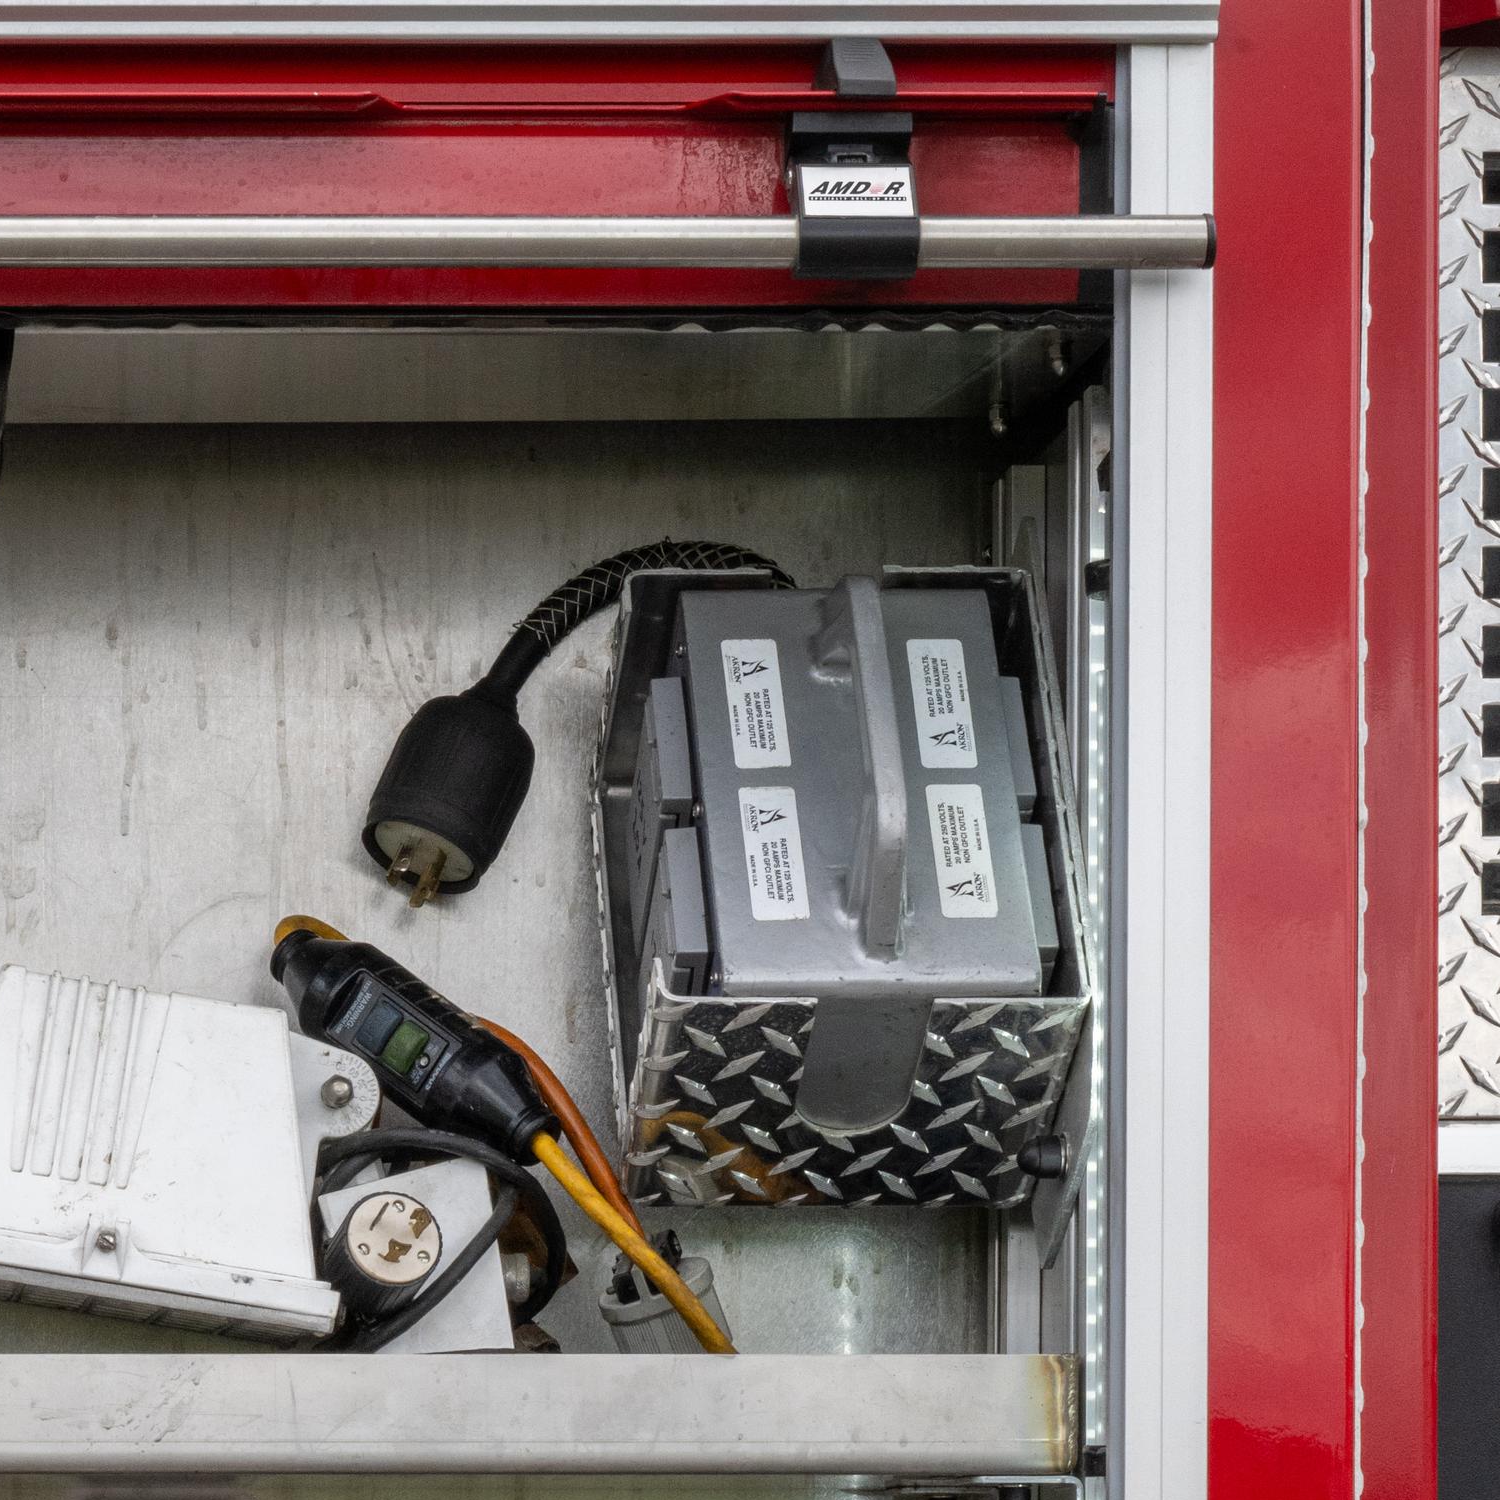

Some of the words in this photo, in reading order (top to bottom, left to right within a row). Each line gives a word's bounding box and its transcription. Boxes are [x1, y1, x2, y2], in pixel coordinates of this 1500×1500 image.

[732, 656, 741, 683] AKRON
[931, 658, 941, 687] MAXIMUM
[941, 659, 949, 682] OUTLET
[746, 708, 754, 722] GFCI
[754, 700, 763, 718] AMPS
[928, 697, 936, 717] RATED
[938, 707, 944, 715] 20
[748, 724, 757, 748] OUTLET
[757, 719, 766, 748] MAXIMUM
[957, 724, 966, 750] AKRON
[749, 804, 758, 831] AKRON
[948, 806, 957, 836] MAXIMUM
[957, 806, 966, 831] OUTLET
[780, 838, 788, 859] RATED
[944, 846, 952, 867] RATED
[952, 837, 960, 855] AMPS
[764, 858, 772, 873] GFCI
[772, 850, 780, 868] AMPS
[766, 875, 774, 899] OUTLET
[775, 870, 784, 900] MAXIMUM
[975, 874, 984, 902] AKRON
